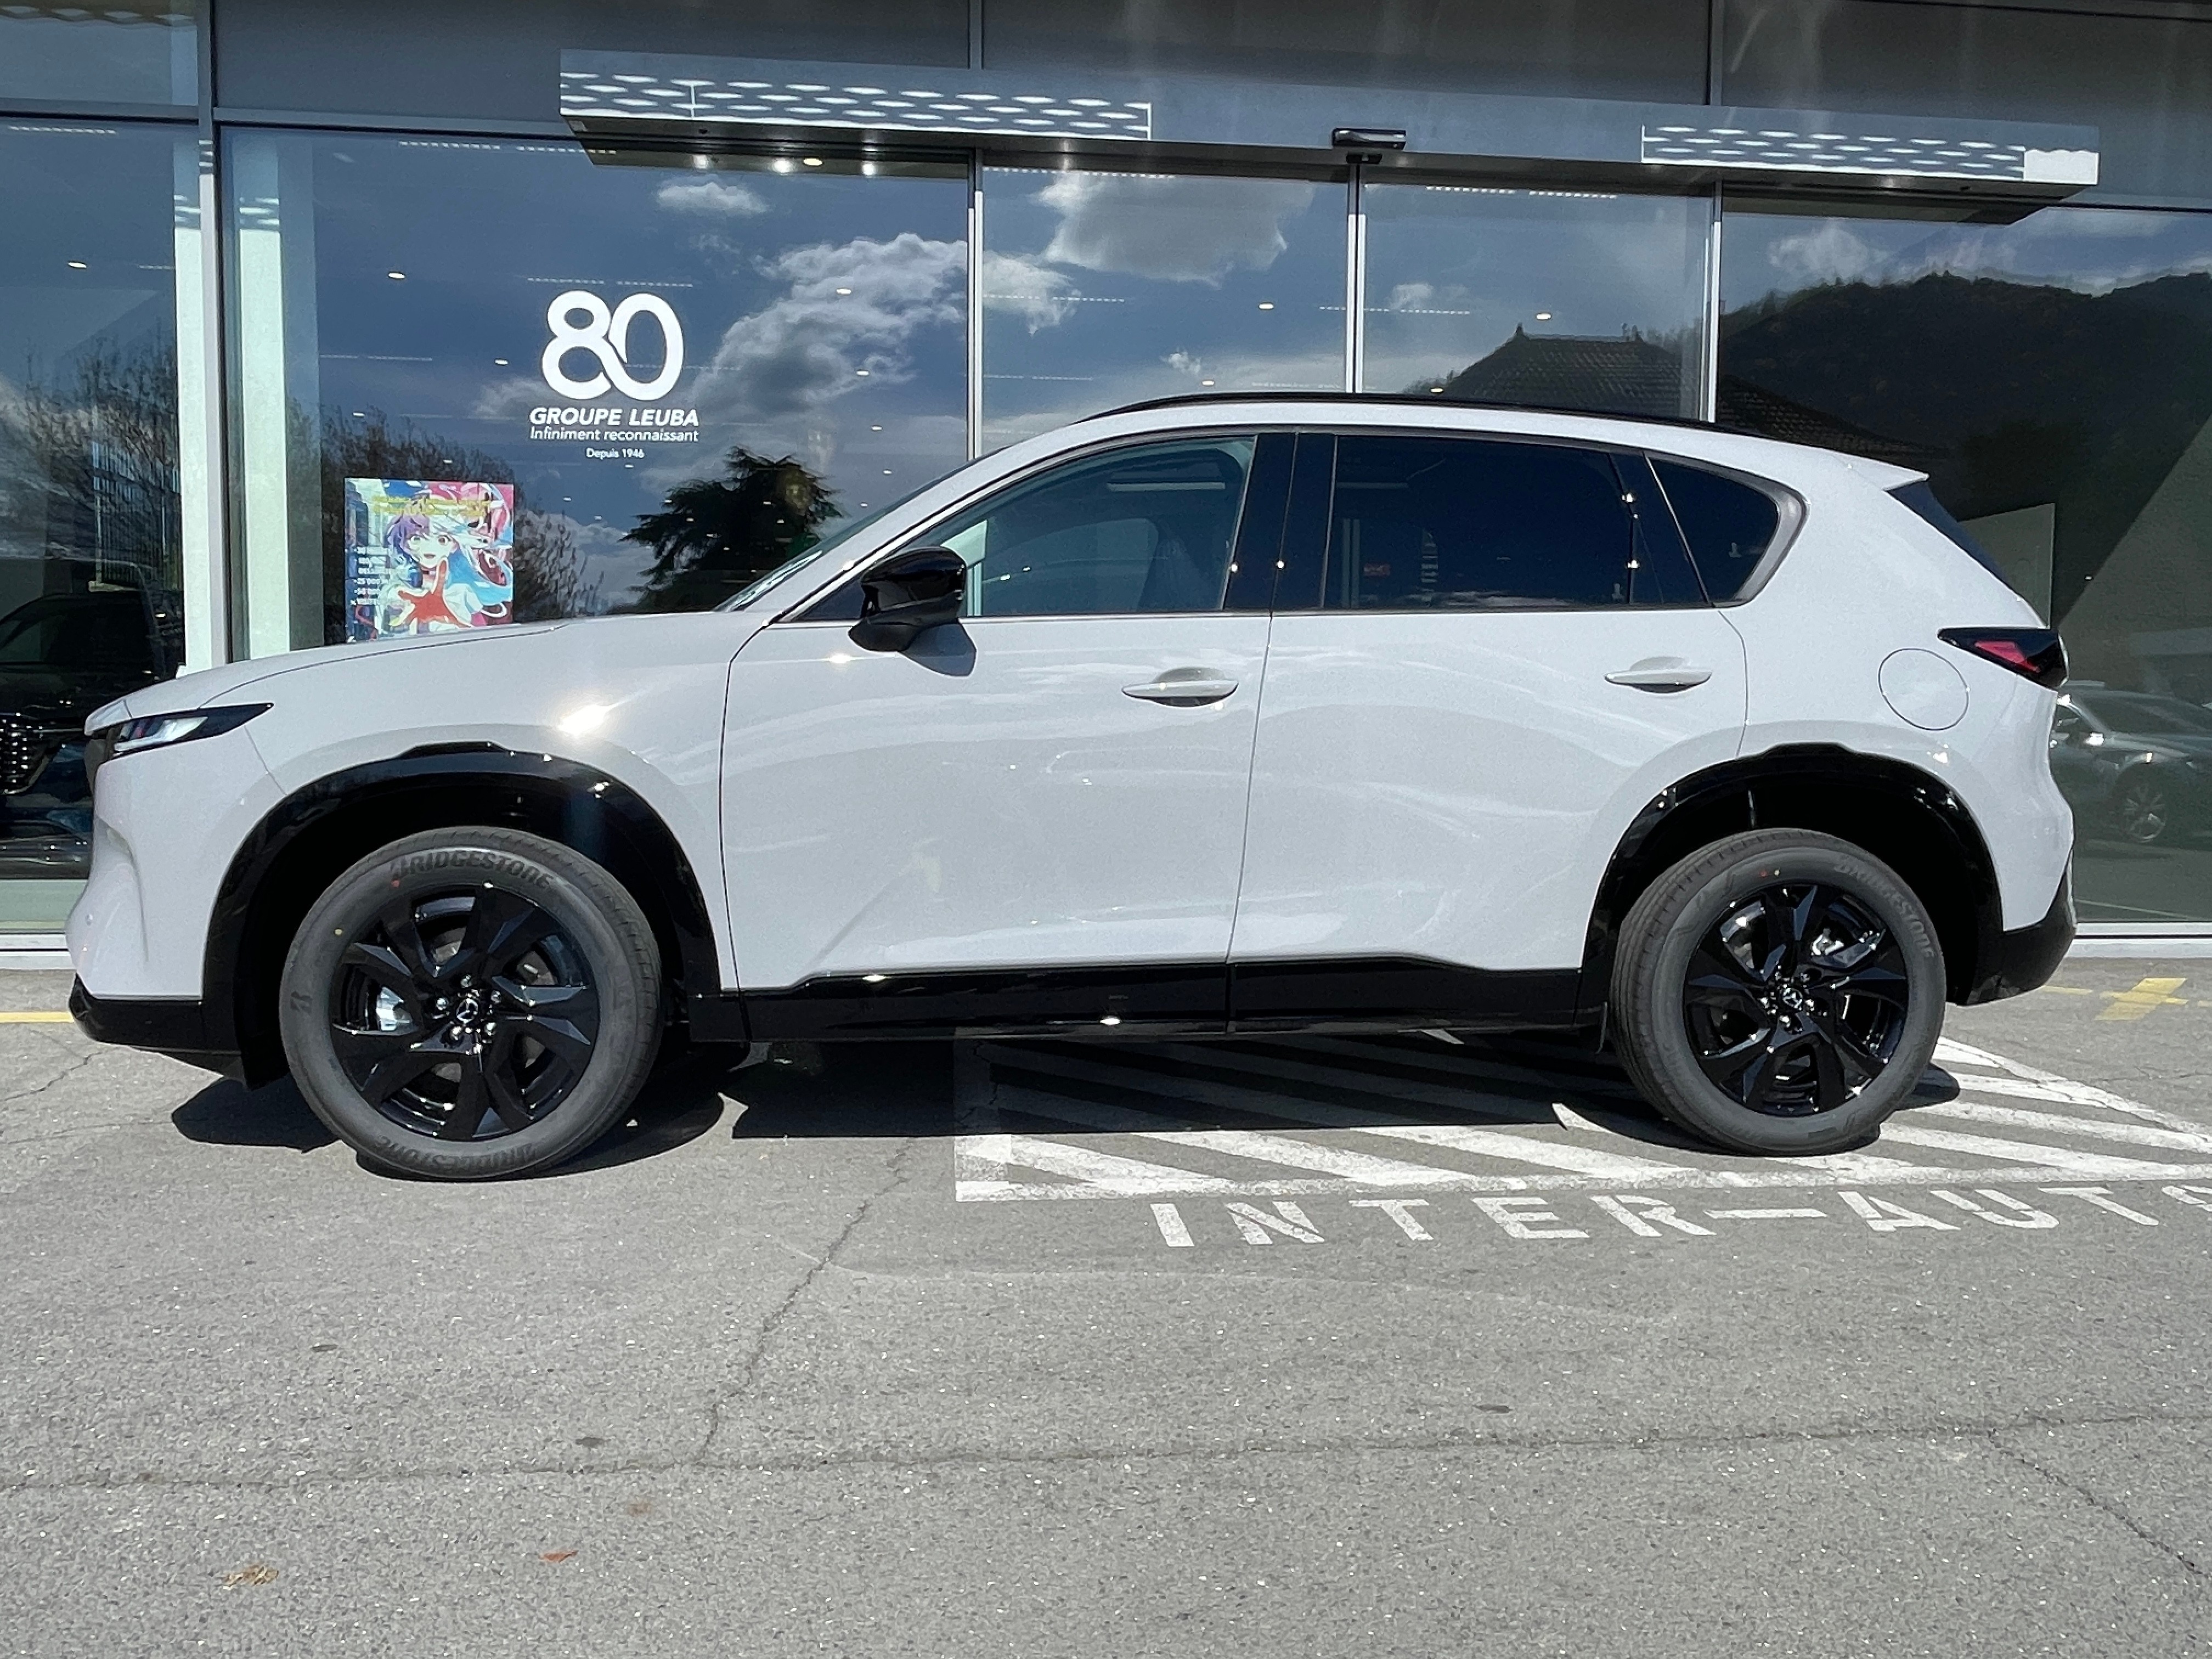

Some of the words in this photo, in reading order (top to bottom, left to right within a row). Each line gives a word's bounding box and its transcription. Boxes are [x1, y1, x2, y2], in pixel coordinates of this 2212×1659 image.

[542, 290, 684, 400] 80
[529, 407, 623, 426] GROUPE
[629, 408, 699, 427] LEUBA
[530, 426, 601, 441] Infiniment
[603, 428, 699, 441] reconnaissant
[586, 448, 619, 460] Depuis
[622, 448, 645, 459] 1946
[390, 850, 554, 889] BRIDGESTONE
